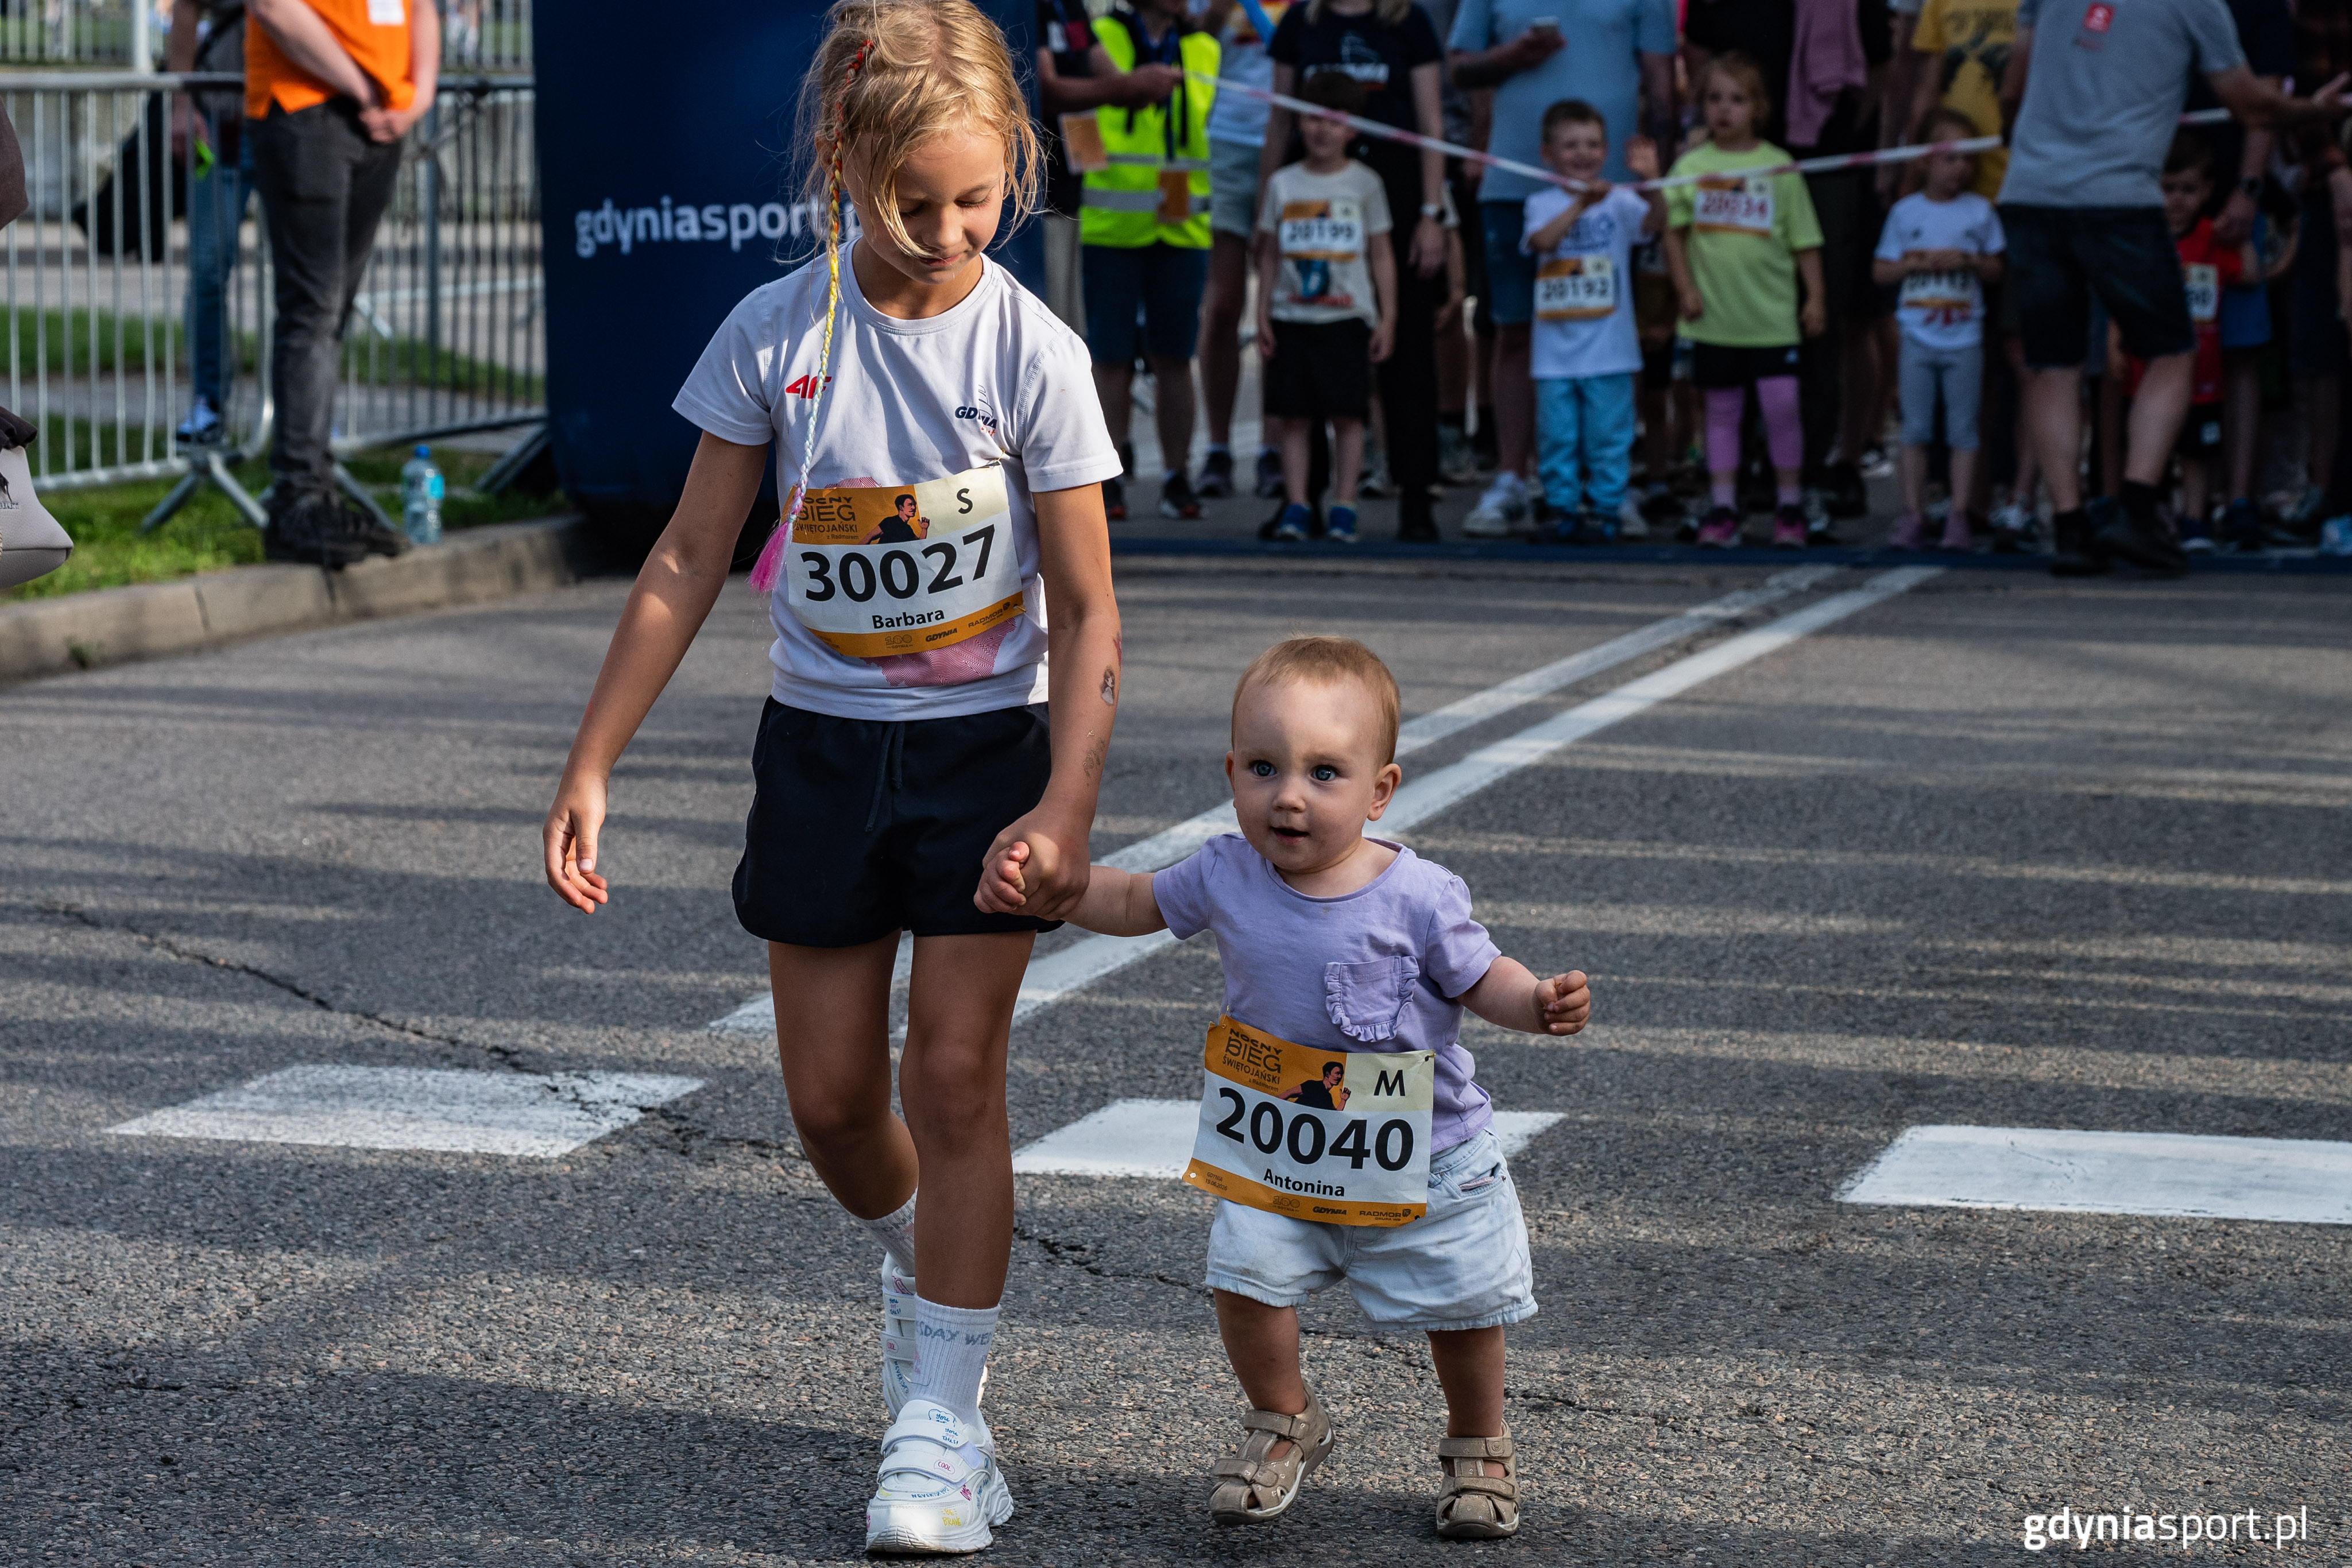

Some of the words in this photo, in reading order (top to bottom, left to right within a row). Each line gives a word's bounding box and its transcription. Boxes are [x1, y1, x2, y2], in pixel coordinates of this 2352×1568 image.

[793, 496, 853, 504] OCNY
[957, 488, 973, 514] S
[800, 524, 995, 602] 30027
[872, 608, 945, 629] Barbara
[968, 608, 1004, 629] RADMOR
[885, 634, 912, 645] 100
[926, 628, 958, 642] GDYNIA
[1229, 1028, 1283, 1055] NOCNY
[1225, 1036, 1281, 1074] BIEG
[1222, 1053, 1281, 1085] ŚWIĘTOJAŃSKI
[1252, 1079, 1278, 1093] Radmorem
[1373, 1070, 1406, 1097] M
[1216, 1087, 1414, 1172] 20040
[1205, 1179, 1228, 1191] 19.06.2026
[1207, 1172, 1223, 1182] GDYNIA
[1263, 1168, 1345, 1197] Antonina
[1272, 1196, 1300, 1209] 100
[1313, 1206, 1347, 1215] GDYNIA
[938, 1461, 951, 1472] COOL
[942, 1516, 962, 1527] BRAVE
